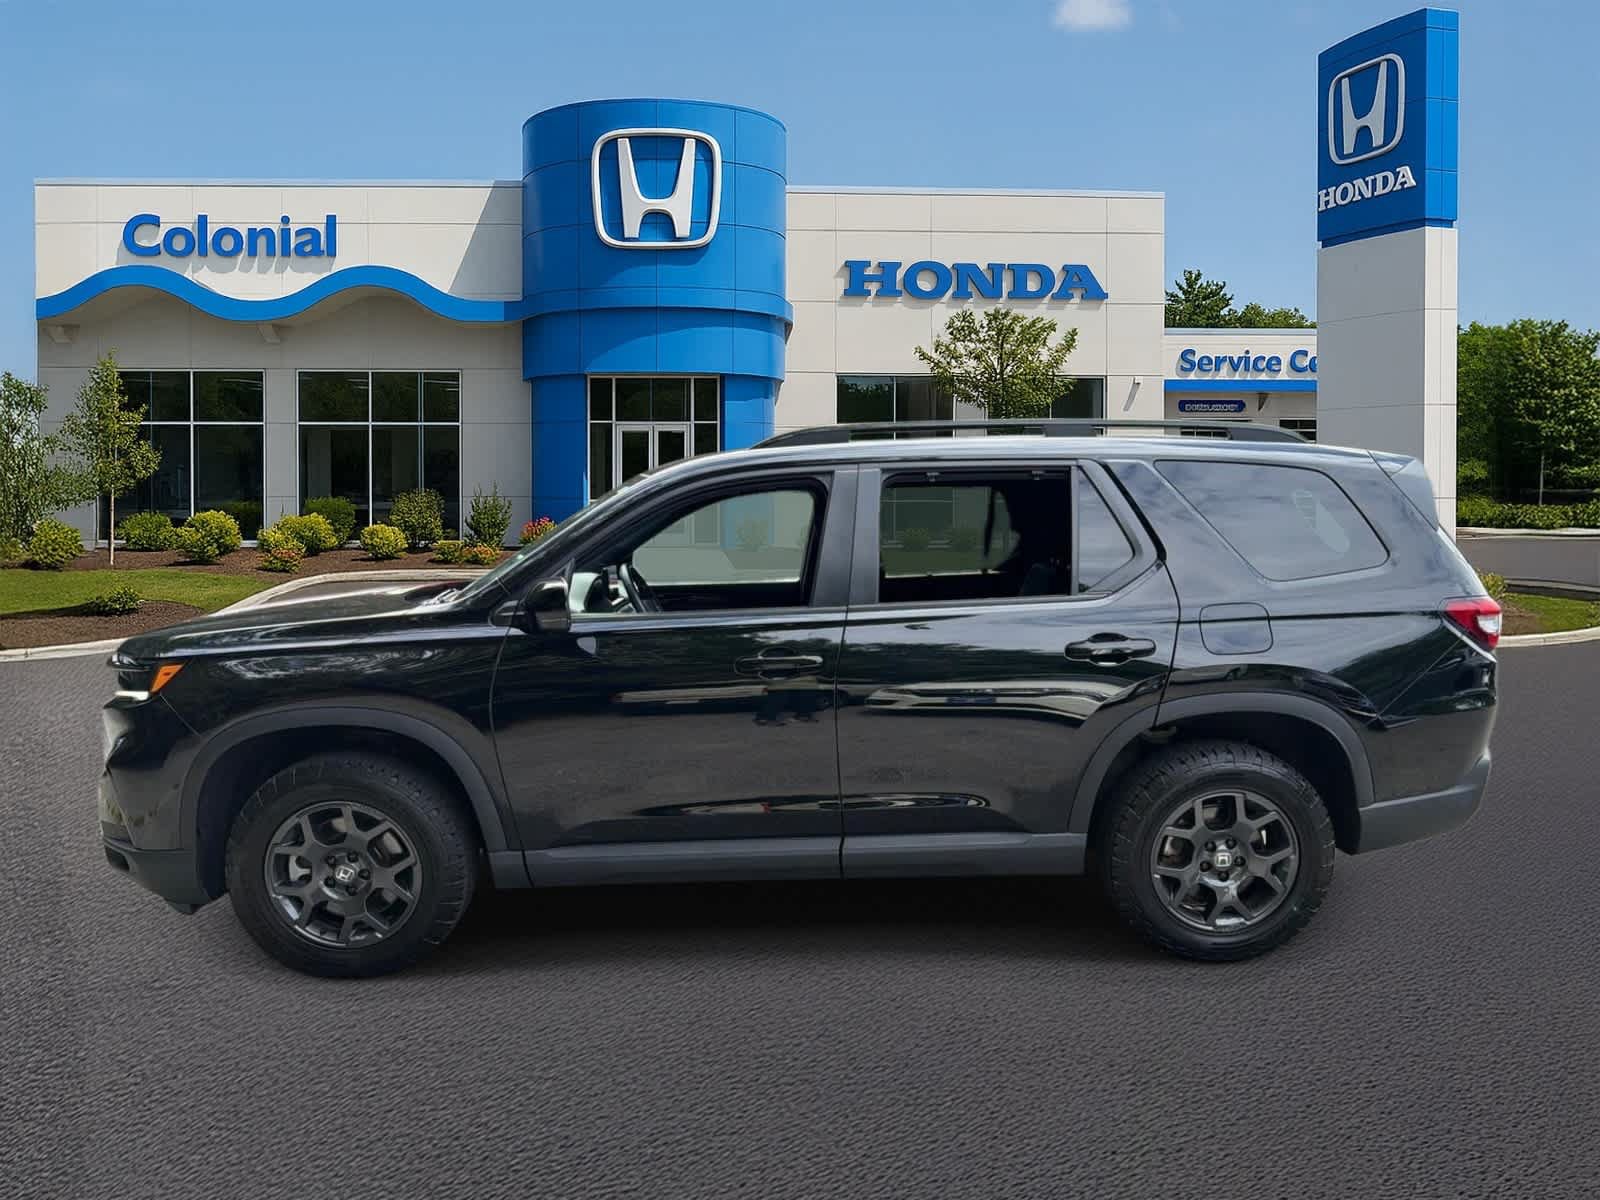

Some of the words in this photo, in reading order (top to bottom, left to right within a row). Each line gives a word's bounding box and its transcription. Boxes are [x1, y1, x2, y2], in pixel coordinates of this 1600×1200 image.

[1318, 165, 1417, 212] HONDA
[122, 213, 337, 257] Colonial
[843, 260, 1108, 299] HONDA
[1179, 348, 1282, 373] Service
